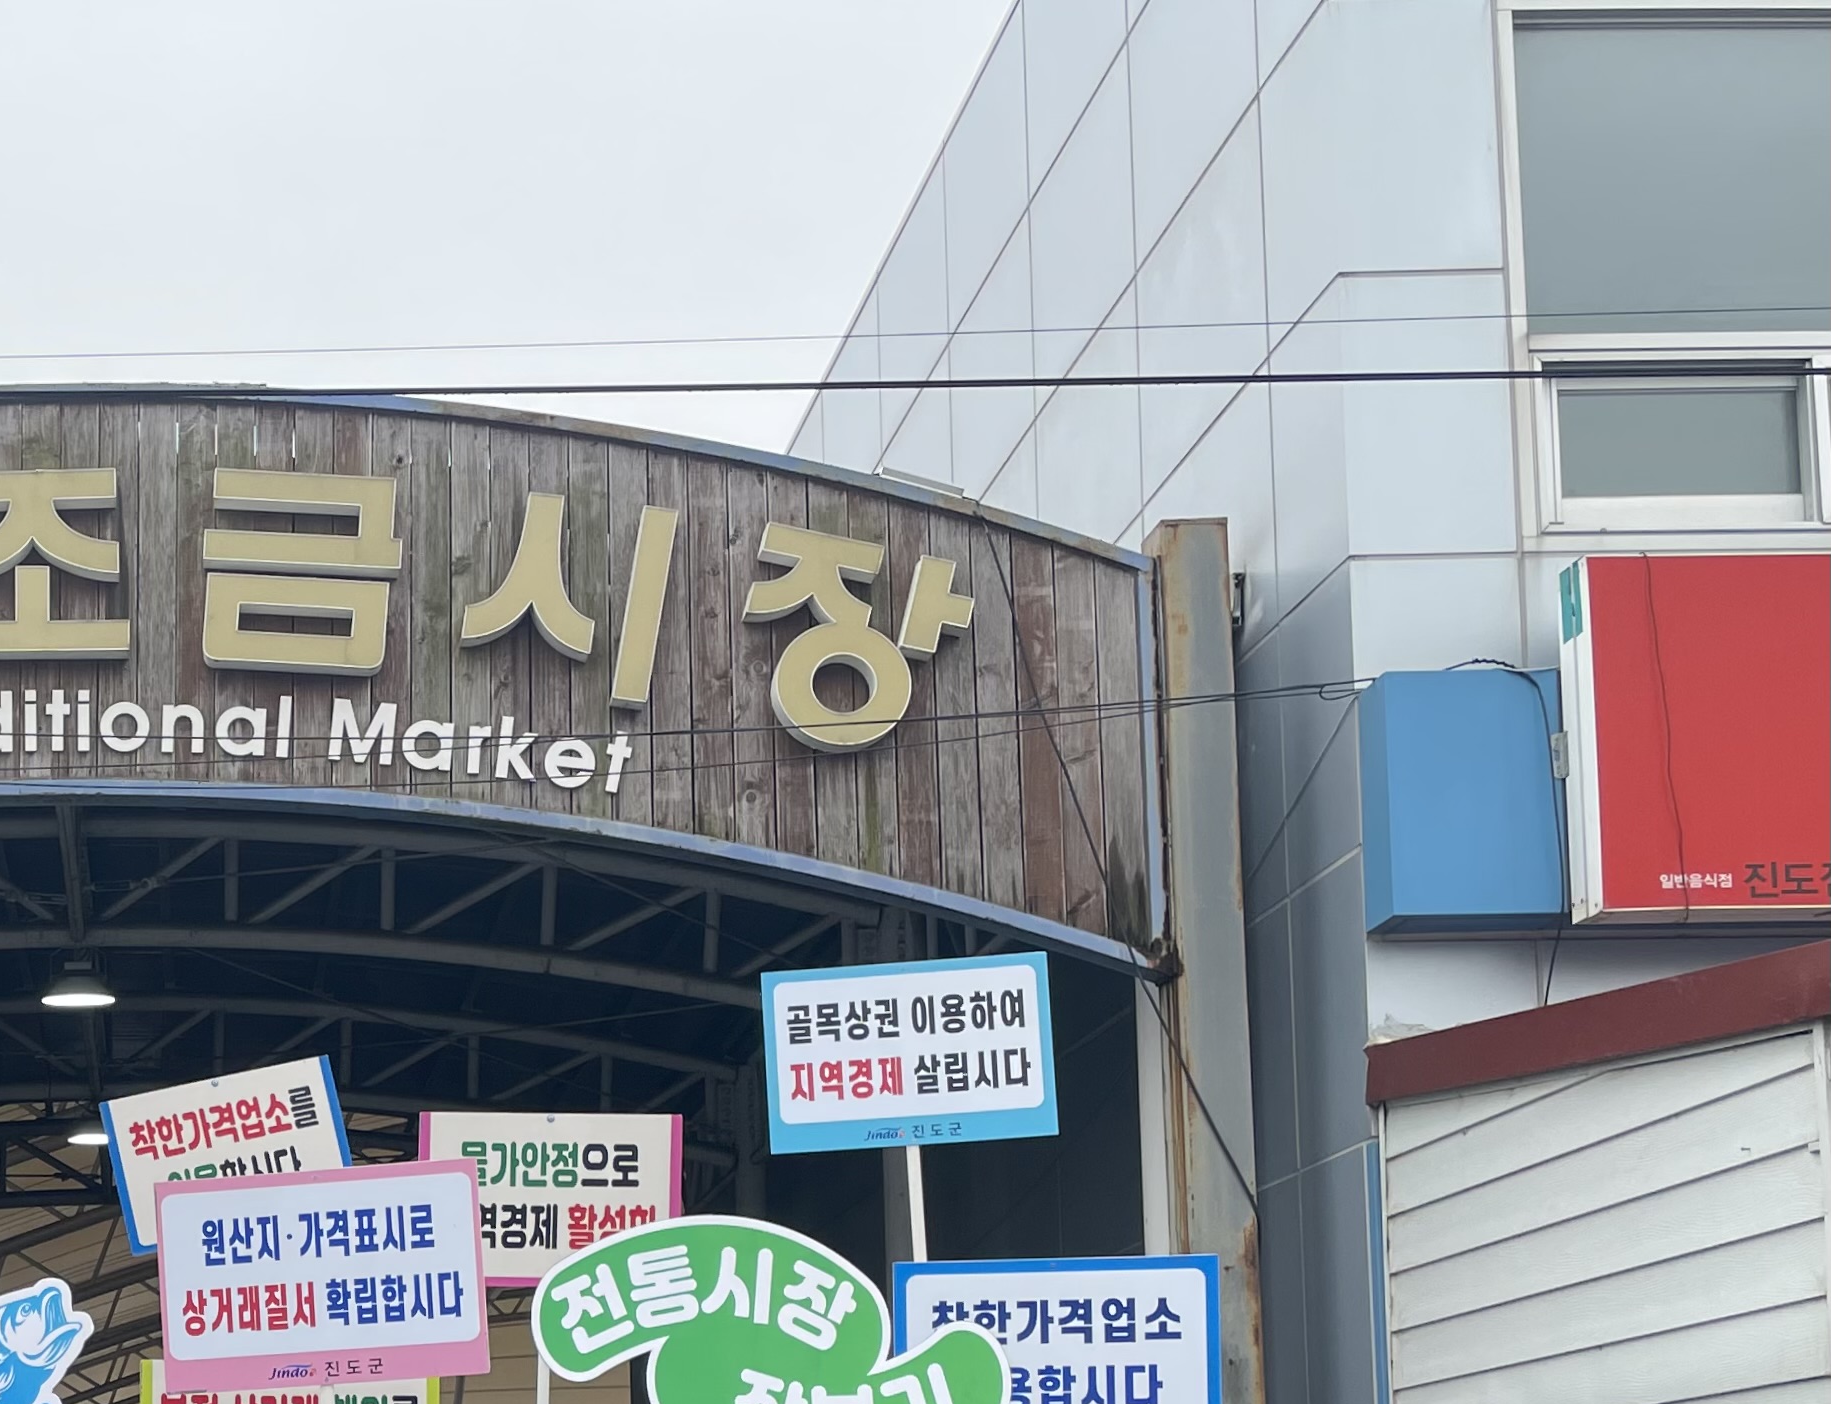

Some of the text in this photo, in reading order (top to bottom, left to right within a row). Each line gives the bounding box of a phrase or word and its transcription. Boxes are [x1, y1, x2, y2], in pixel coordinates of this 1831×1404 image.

[327, 697, 633, 794] Market
[1659, 873, 1733, 889] 일반음식점
[786, 988, 1027, 1045] 골목상권 이용하여
[790, 1047, 1032, 1102] 지역경제 살립시다
[128, 1084, 320, 1161] 착한가격업소를
[182, 1270, 465, 1337] 상거래질서 확립합시다
[550, 1245, 859, 1356] 전통시장
